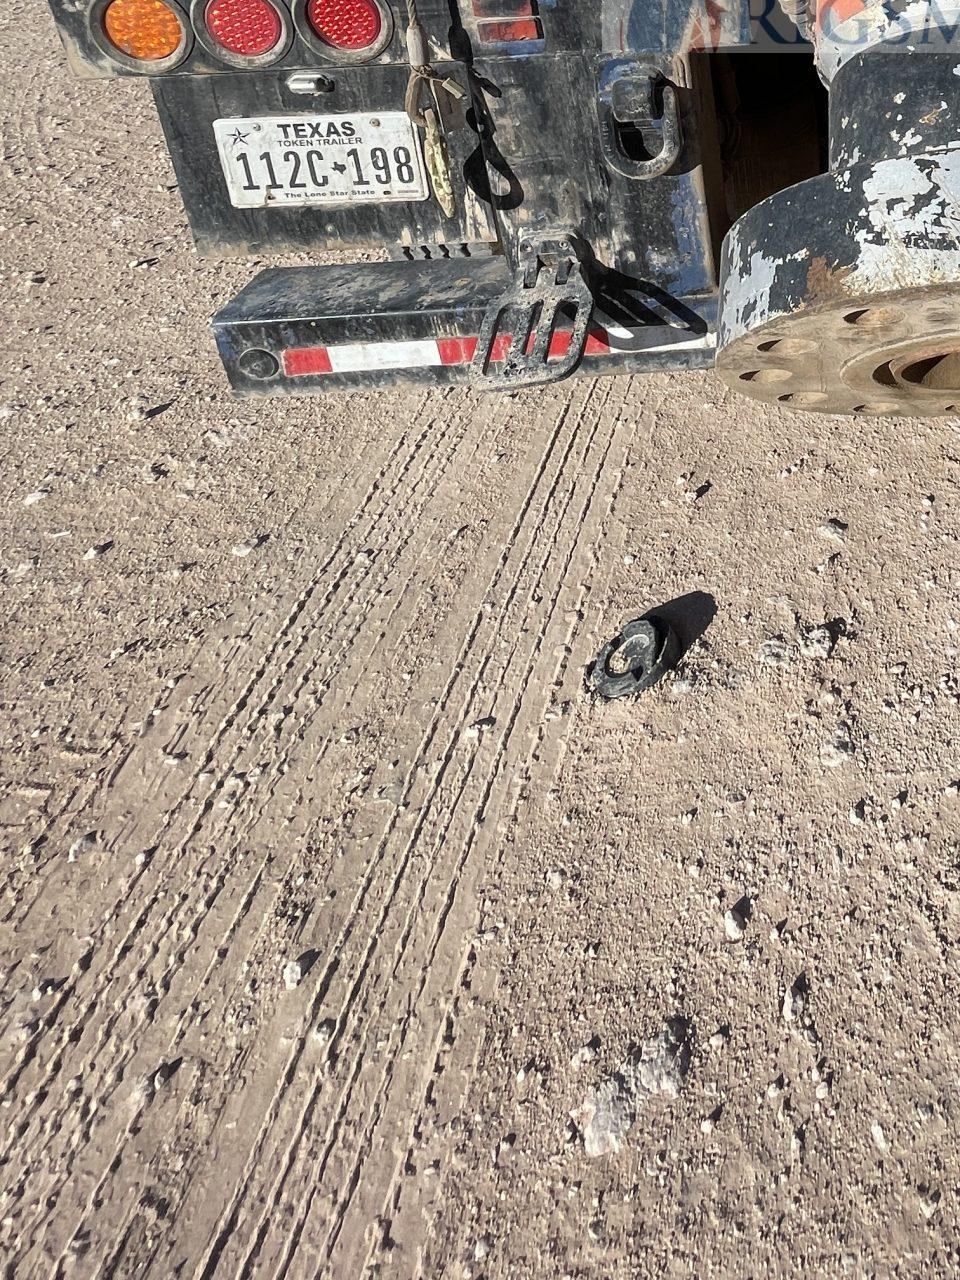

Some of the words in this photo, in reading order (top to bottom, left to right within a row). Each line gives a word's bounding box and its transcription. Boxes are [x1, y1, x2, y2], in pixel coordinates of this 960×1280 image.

[276, 121, 356, 140] TEXAS
[277, 139, 314, 147] TOKEN
[315, 136, 363, 146] TRAILER
[236, 149, 329, 191] 112C
[346, 146, 415, 186] 198
